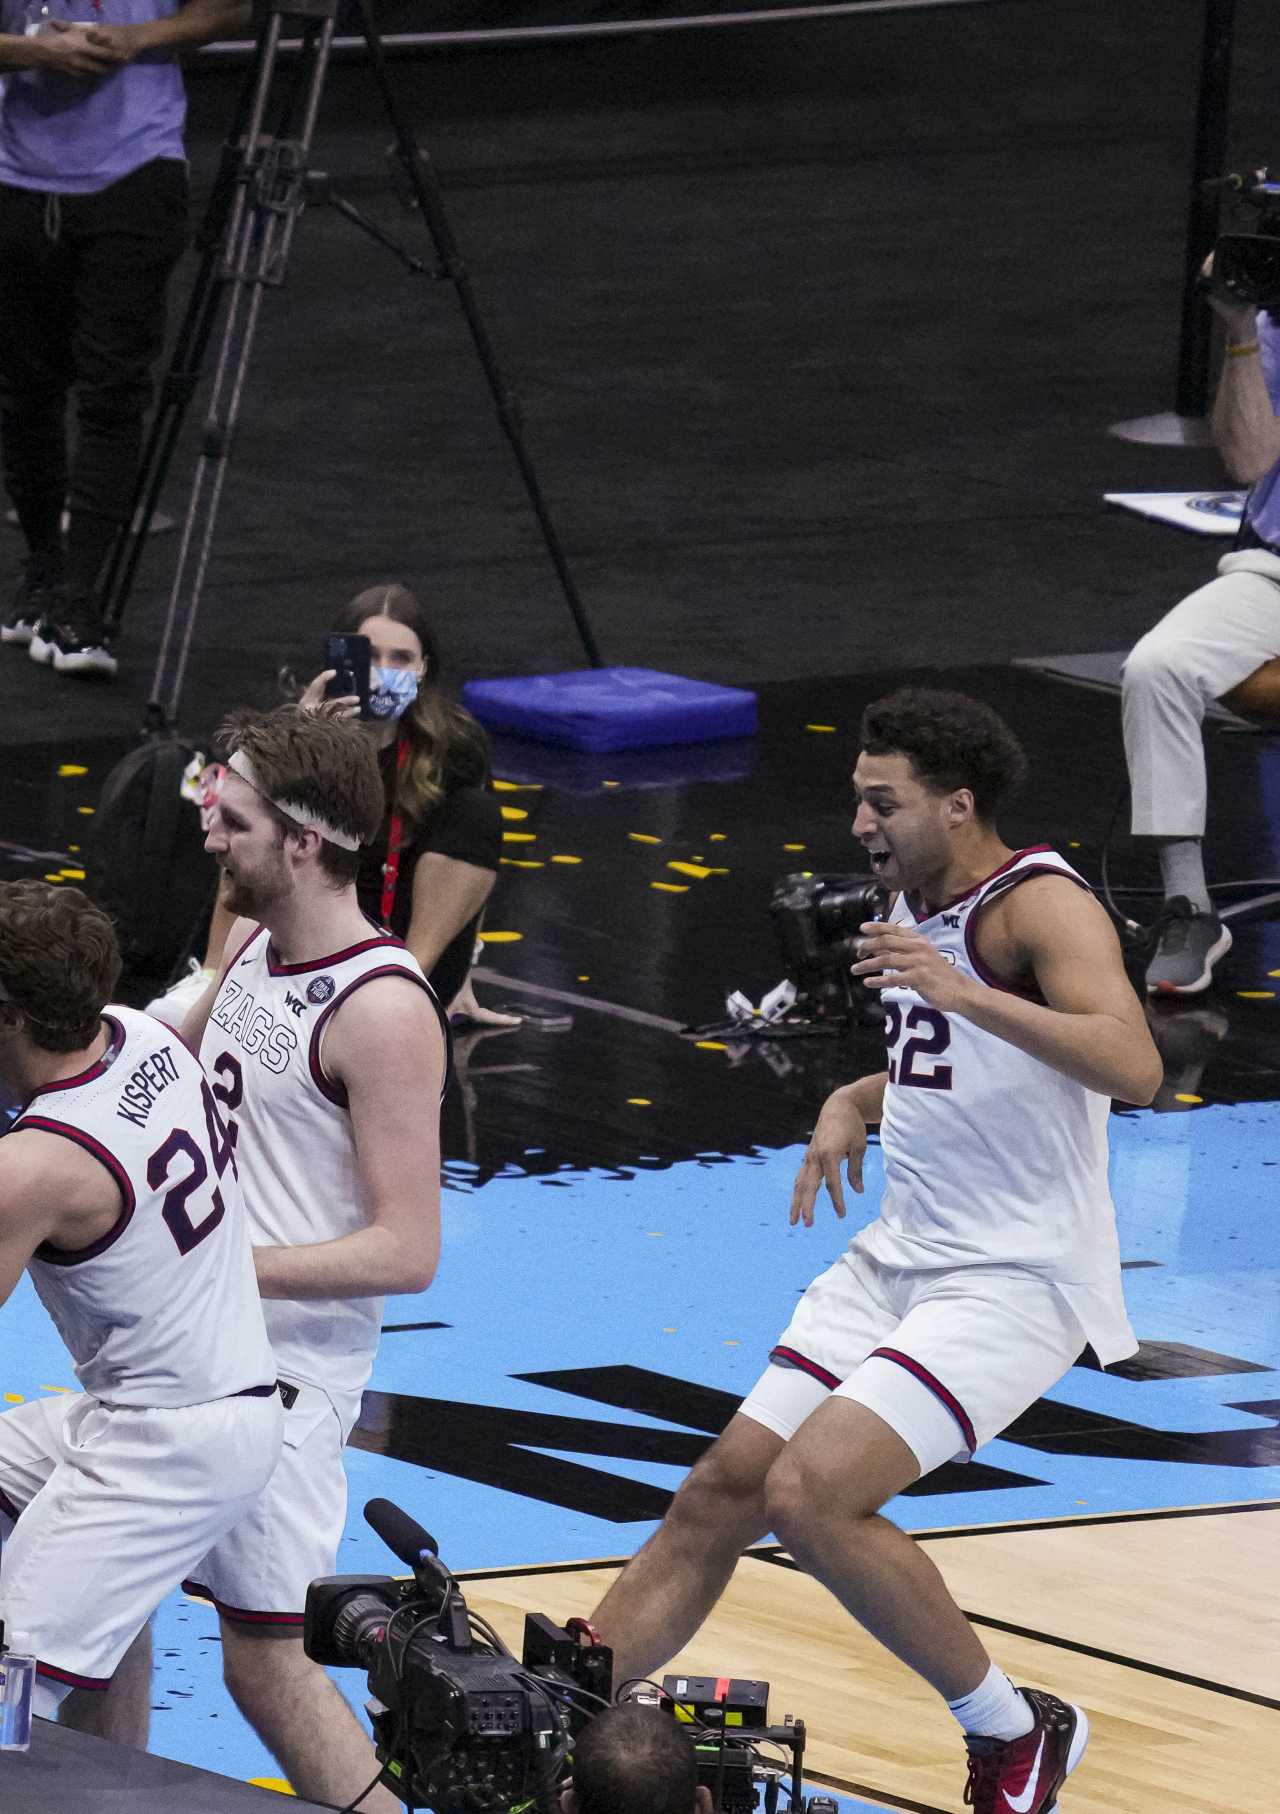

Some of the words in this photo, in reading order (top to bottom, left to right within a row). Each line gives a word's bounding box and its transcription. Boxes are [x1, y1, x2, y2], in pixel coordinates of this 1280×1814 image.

[209, 979, 298, 1075] ZAGS
[117, 1046, 180, 1129] KISPERT
[146, 1075, 239, 1257] 24
